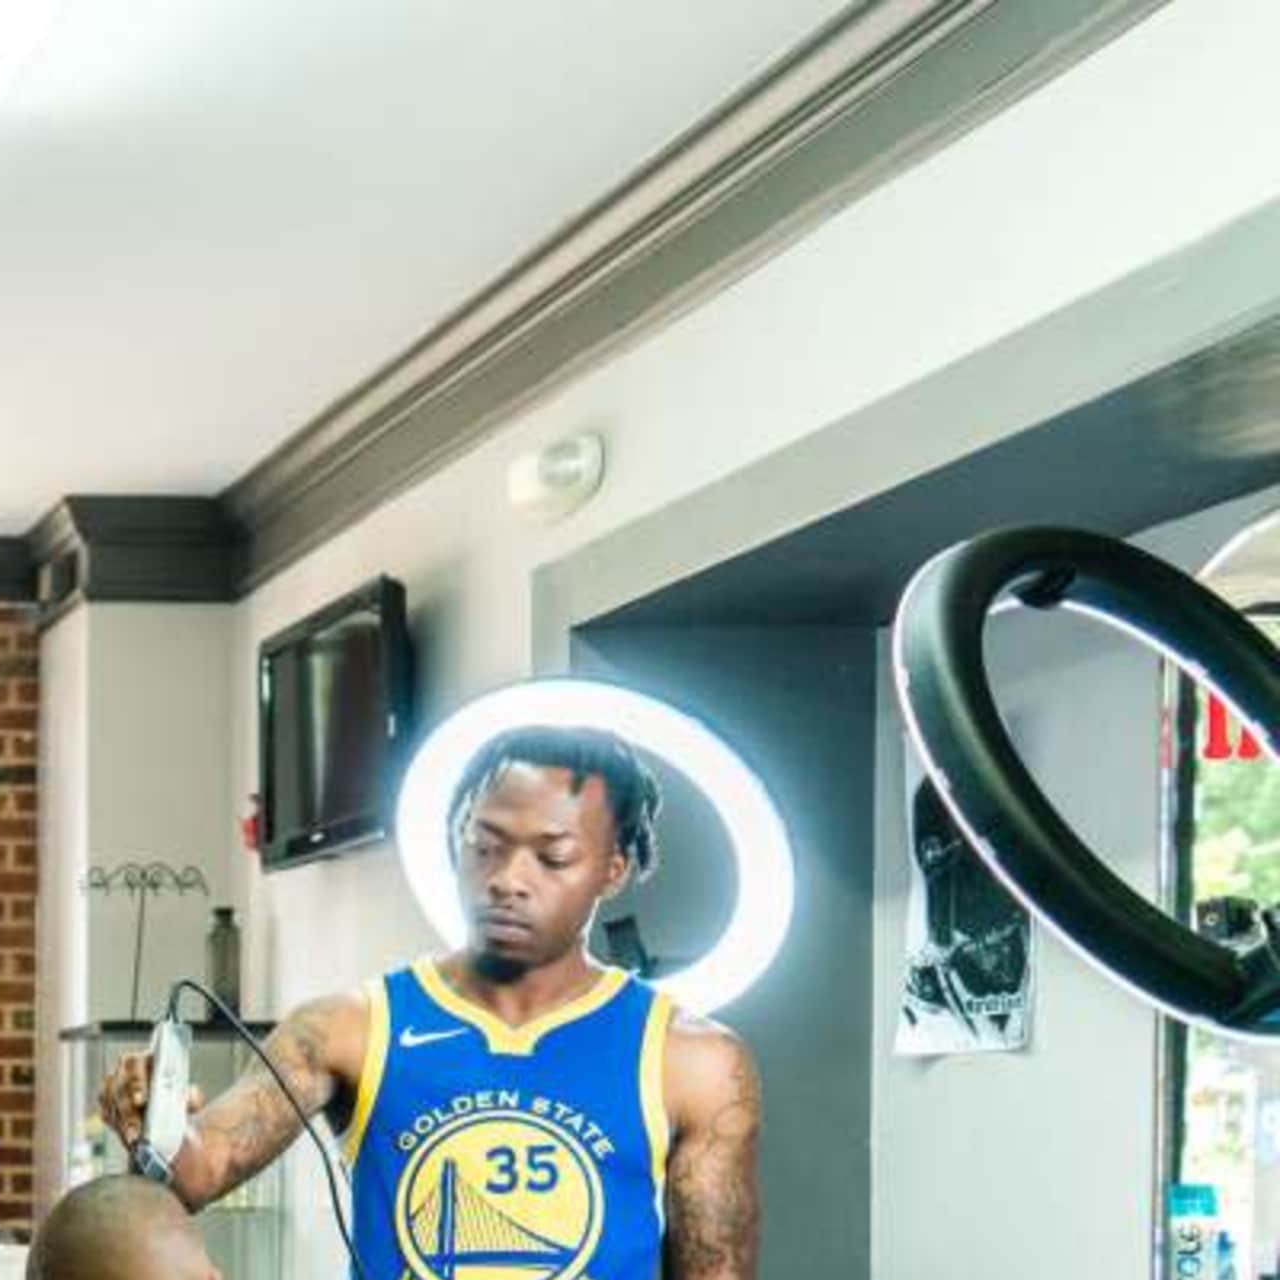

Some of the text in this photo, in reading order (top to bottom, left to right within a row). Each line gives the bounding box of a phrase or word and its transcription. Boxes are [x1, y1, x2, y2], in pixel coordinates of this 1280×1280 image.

[397, 1089, 615, 1160] GOLDEN STATE
[485, 1145, 560, 1195] 35
